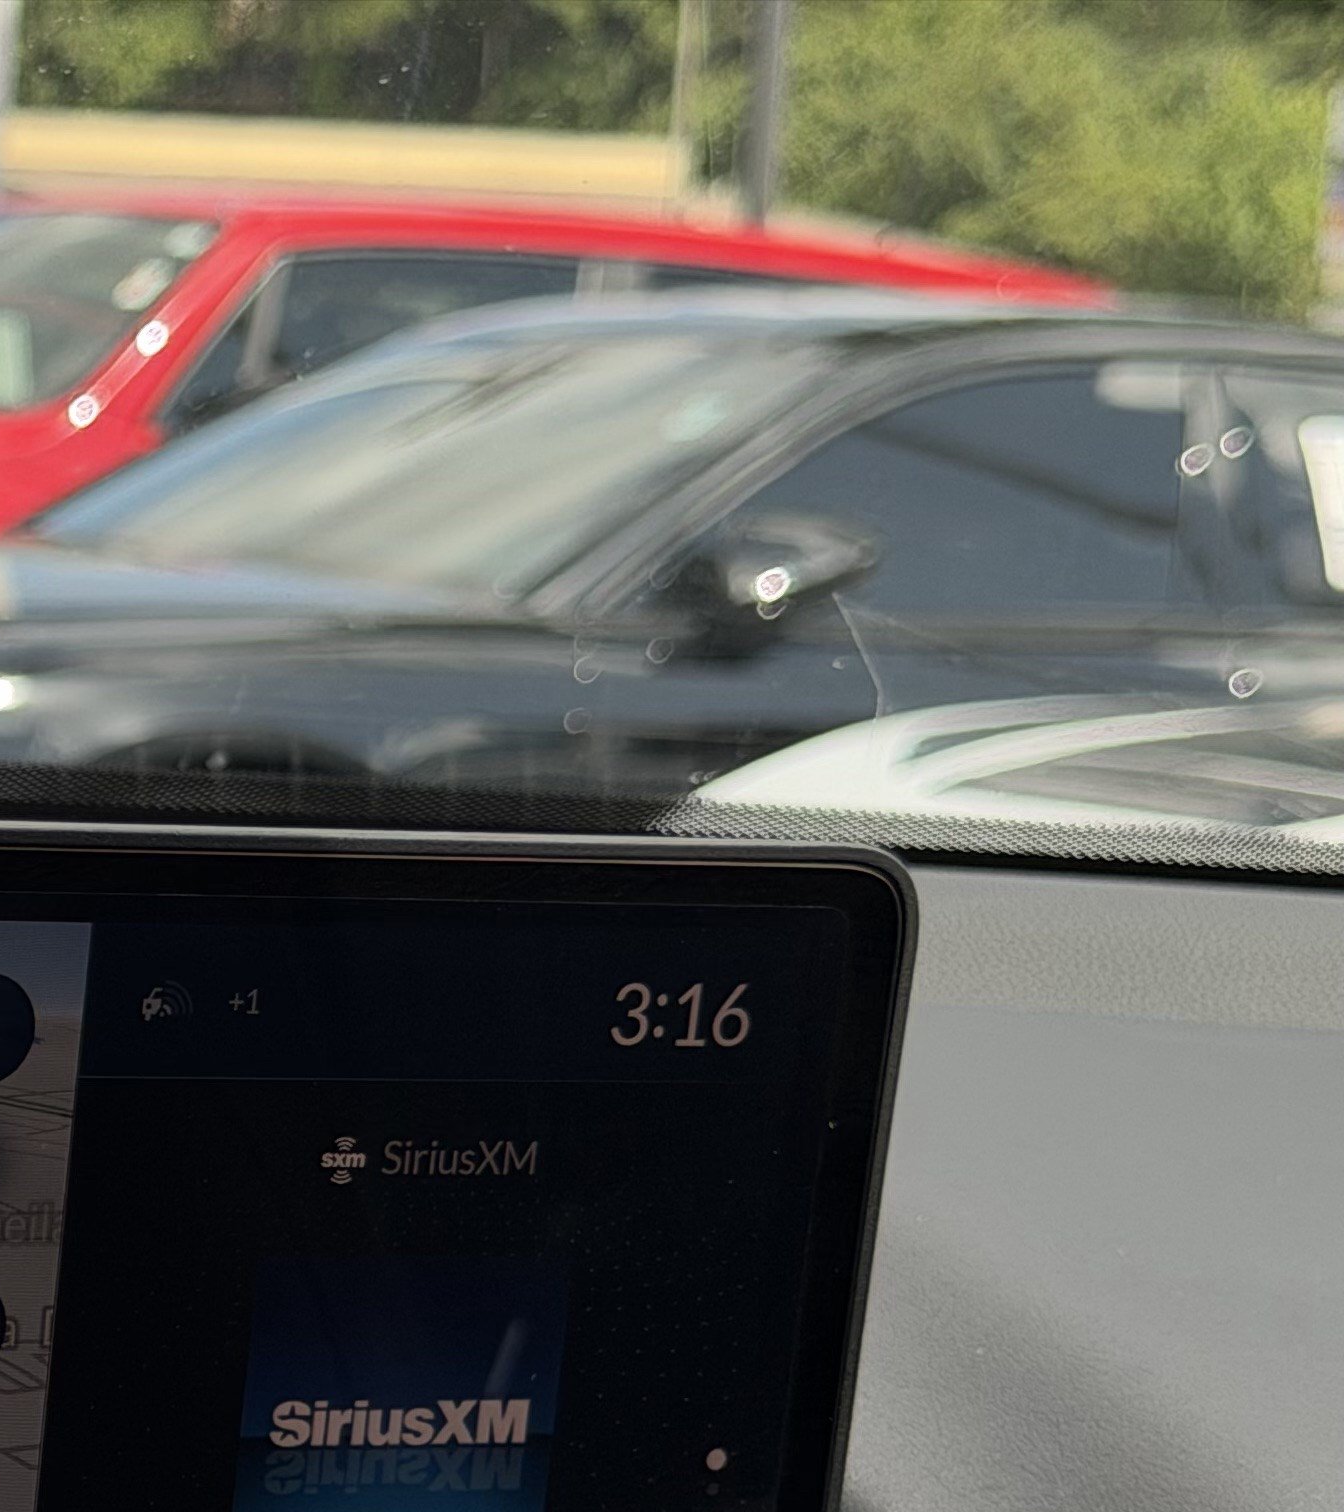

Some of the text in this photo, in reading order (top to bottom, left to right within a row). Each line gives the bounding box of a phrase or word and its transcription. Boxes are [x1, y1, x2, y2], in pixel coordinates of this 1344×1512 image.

[611, 982, 752, 1048] 3:16
[320, 1152, 366, 1169] sxm
[381, 1139, 539, 1176] SiriusXM
[268, 1398, 532, 1449] SiriusXM
